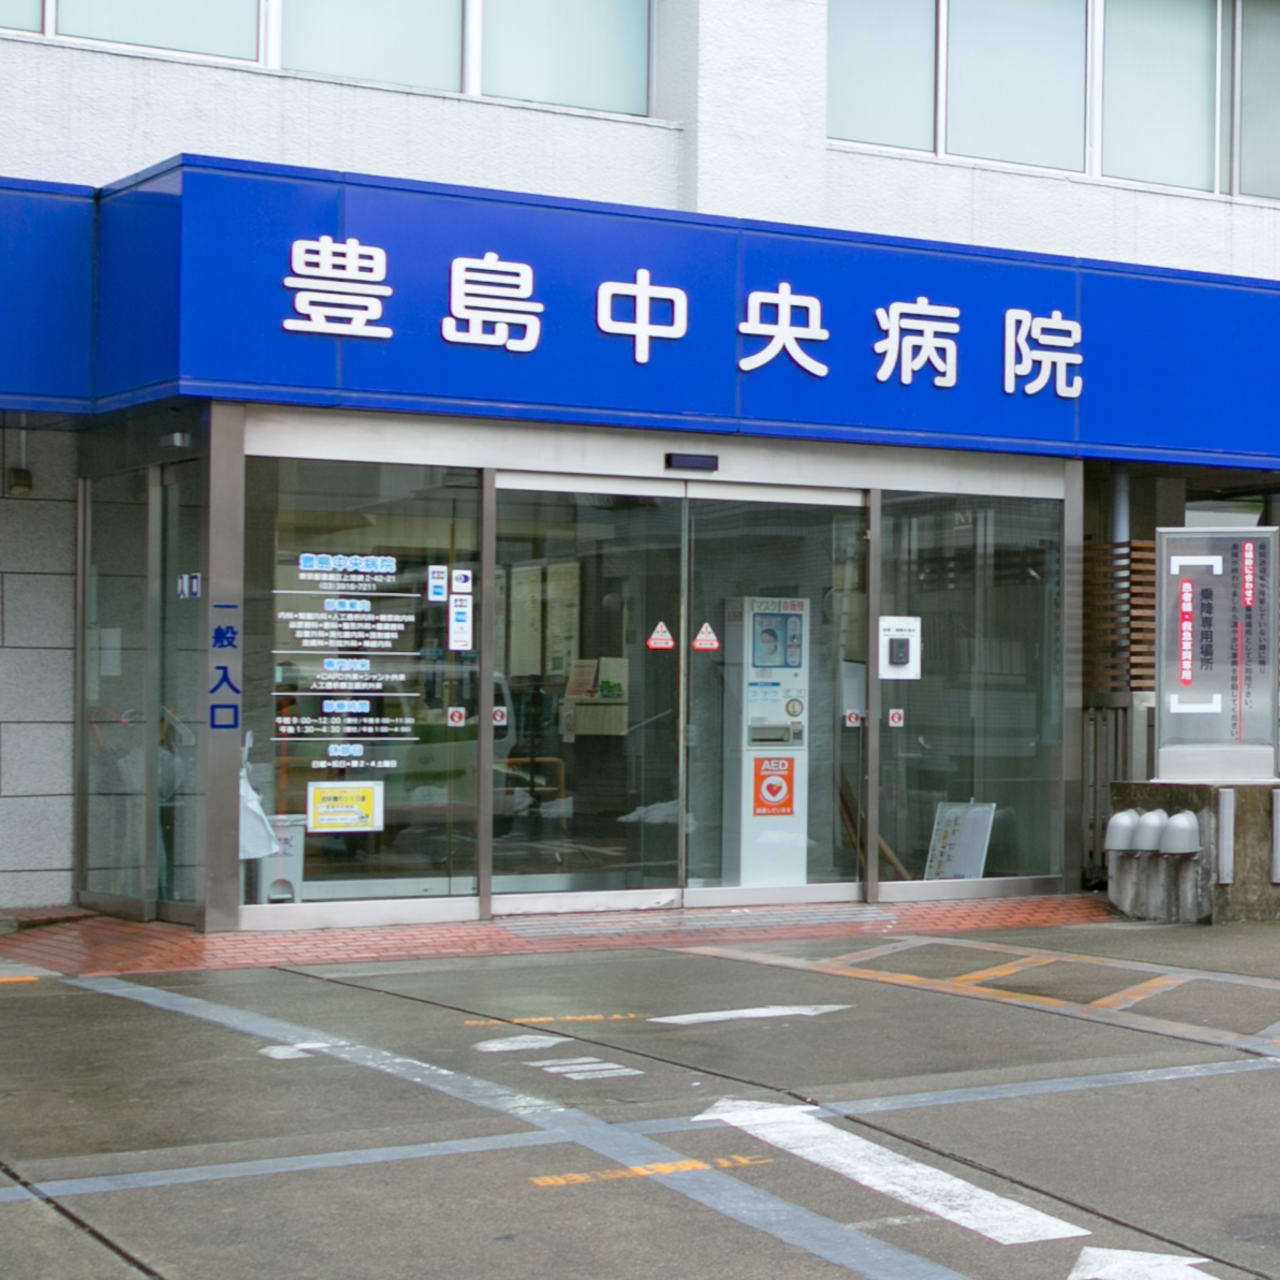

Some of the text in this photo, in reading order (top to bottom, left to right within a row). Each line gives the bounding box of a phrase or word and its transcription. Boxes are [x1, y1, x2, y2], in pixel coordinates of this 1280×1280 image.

[282, 233, 1085, 400] 豊島中央病院
[208, 604, 241, 729] 一般入口
[761, 760, 789, 771] AED
